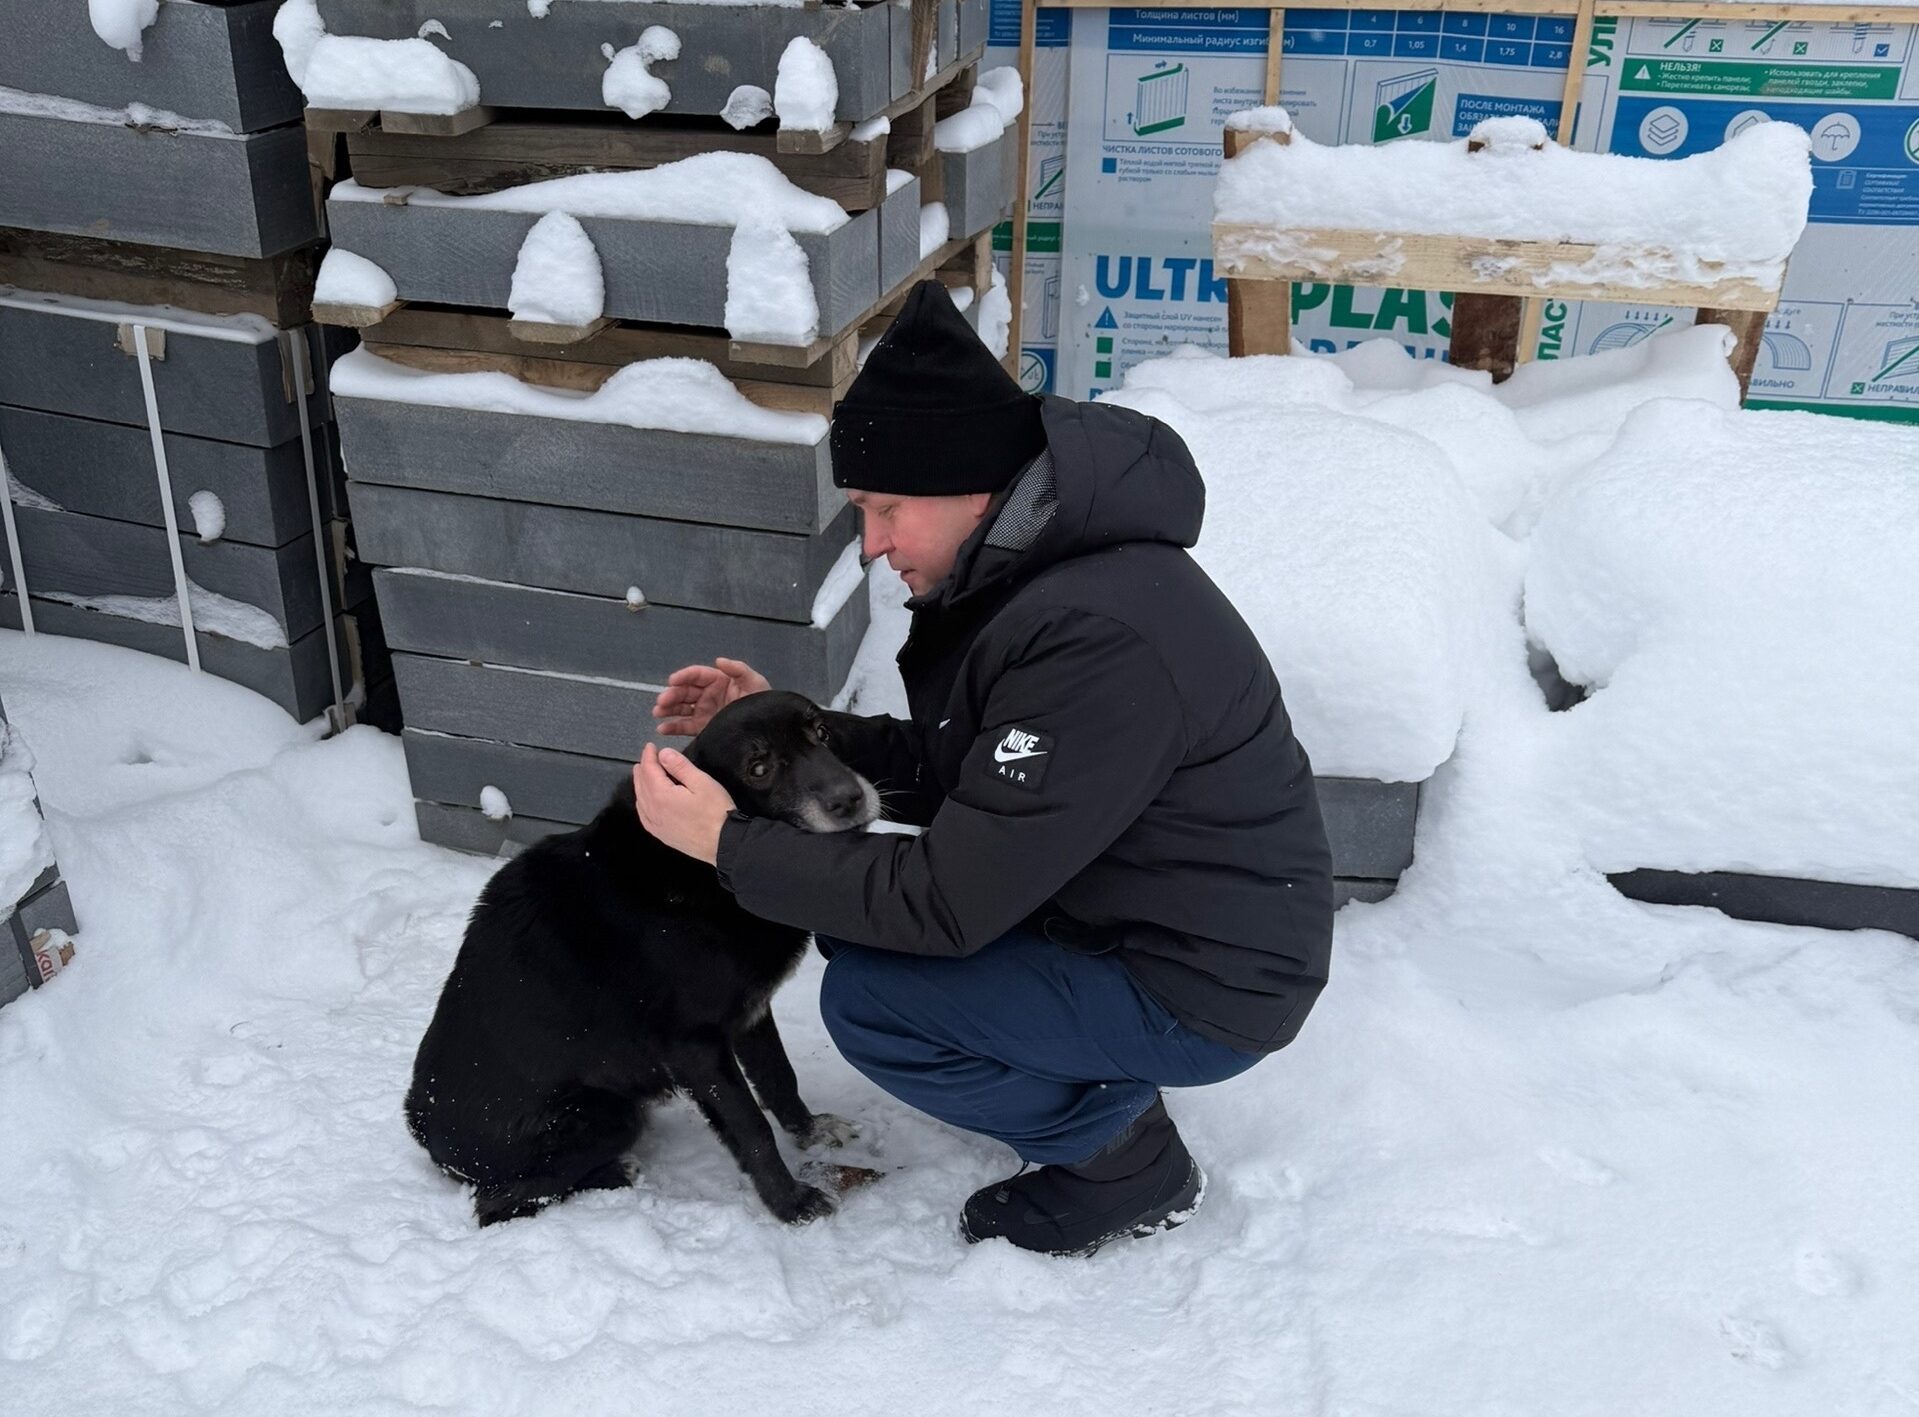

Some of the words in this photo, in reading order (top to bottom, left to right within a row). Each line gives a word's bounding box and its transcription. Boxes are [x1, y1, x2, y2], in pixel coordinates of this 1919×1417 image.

[1135, 9, 1179, 21] Толщина
[1180, 11, 1215, 21] листов
[1217, 11, 1240, 23] (мм)
[1370, 15, 1377, 23] 4
[1417, 16, 1424, 25] 6
[1462, 19, 1469, 28] 8
[1506, 23, 1517, 32] 10
[1554, 25, 1565, 35] 16
[1132, 33, 1204, 45] Минимальный
[1205, 36, 1241, 48] радиус
[1243, 37, 1269, 48] изги
[1364, 39, 1377, 49] 0,7
[1408, 40, 1425, 50] 1,05
[1455, 43, 1467, 53] 1,4
[1499, 47, 1516, 57] 1,75
[1548, 50, 1563, 60] 2,8
[1660, 62, 1702, 73] НЕЛЬЗЯ!
[1460, 99, 1492, 111] ПОСЛЕ
[1494, 102, 1545, 114] МОНТАЖА
[1102, 145, 1136, 153] ЧИСТКА
[1138, 146, 1173, 155] ЛИСТОВ
[1174, 147, 1223, 156] СОТОВОГО
[1180, 313, 1193, 322] UV
[1750, 378, 1795, 389] ВИЛЬНО
[1003, 728, 1040, 753] NIKE
[998, 765, 1026, 782] AIR
